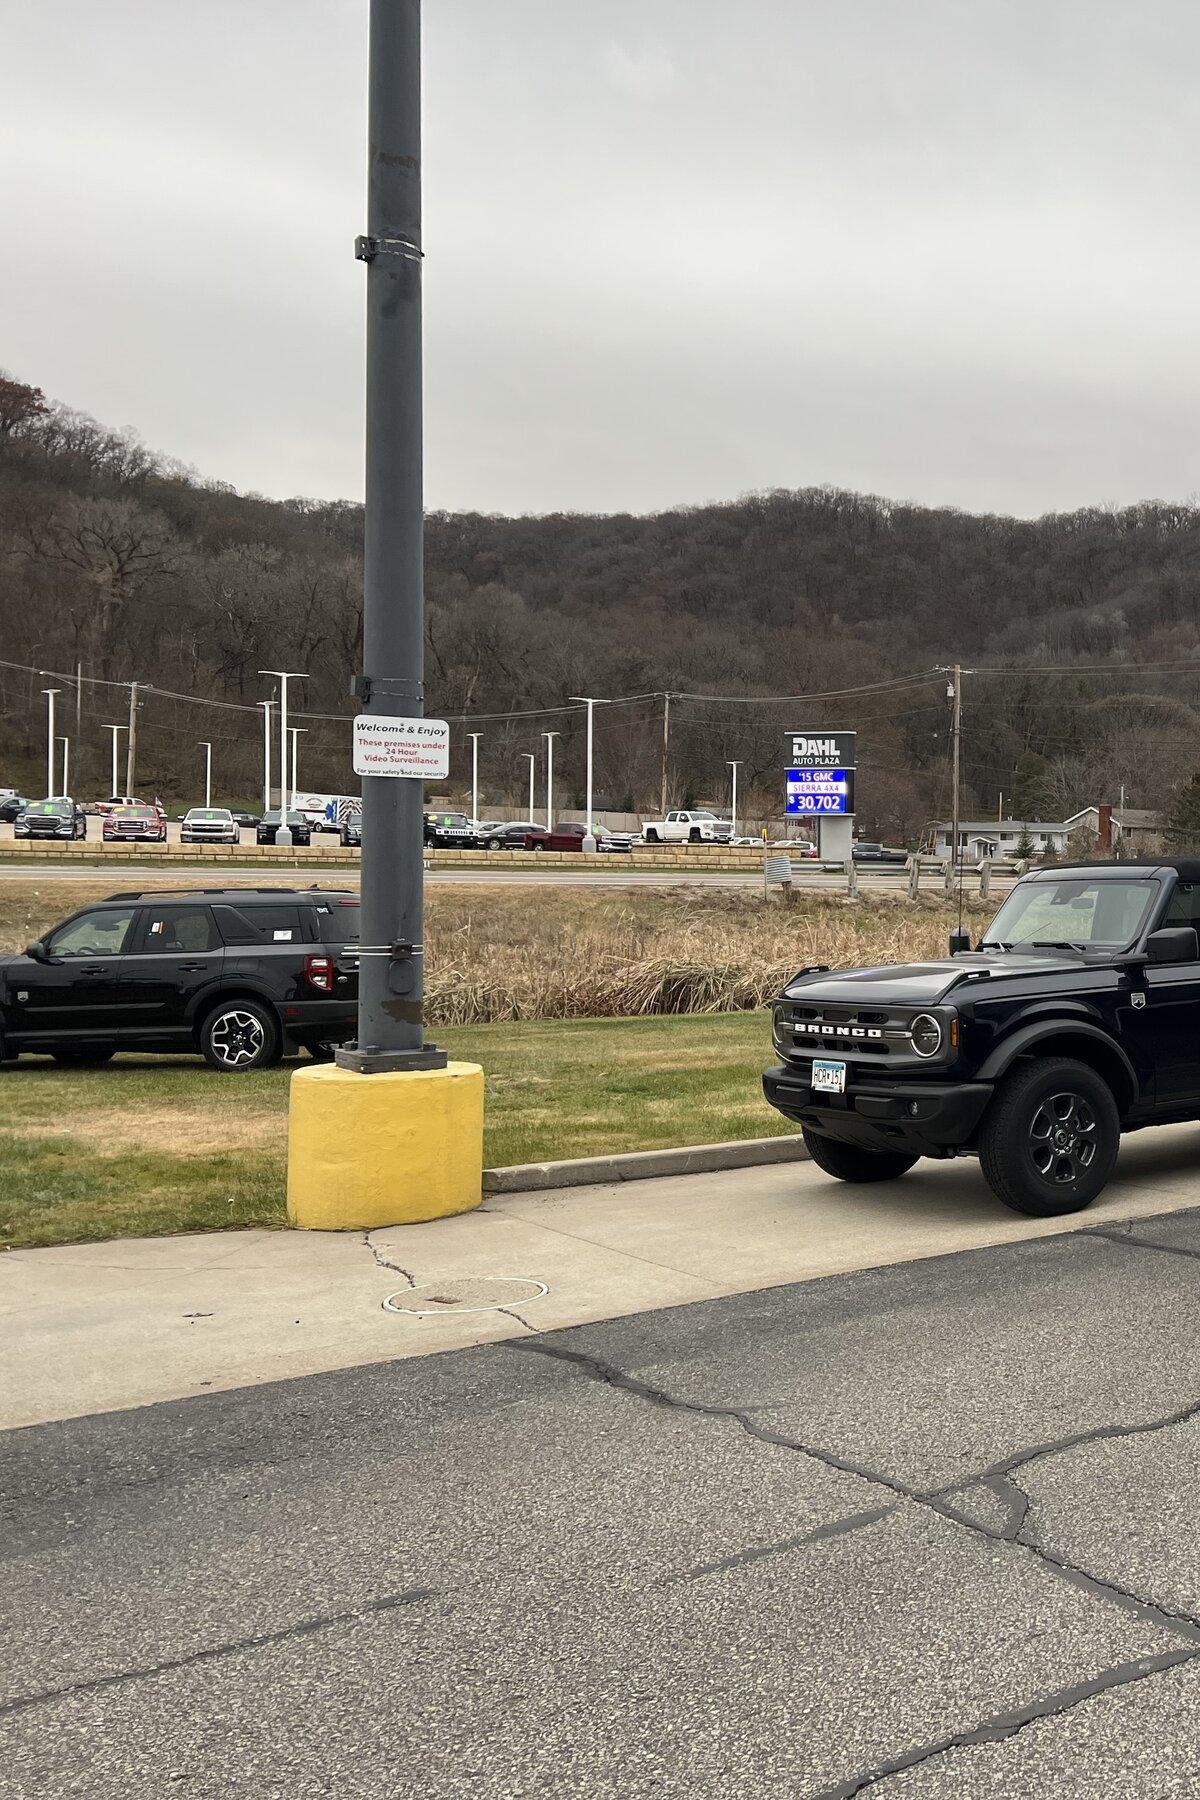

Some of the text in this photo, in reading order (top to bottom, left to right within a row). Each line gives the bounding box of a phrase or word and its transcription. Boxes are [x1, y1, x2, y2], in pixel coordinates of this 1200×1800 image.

[357, 723, 405, 733] Welcome
[417, 727, 447, 736] Enjoy
[358, 739, 382, 747] These
[792, 737, 840, 756] DAHL
[389, 756, 439, 765] Surveillance
[793, 757, 840, 765] AUTO PLAZA
[799, 772, 834, 782] '15 GMC
[793, 784, 822, 792] SIERRA
[797, 795, 840, 811] 30,702
[794, 1023, 882, 1038] BRONCO
